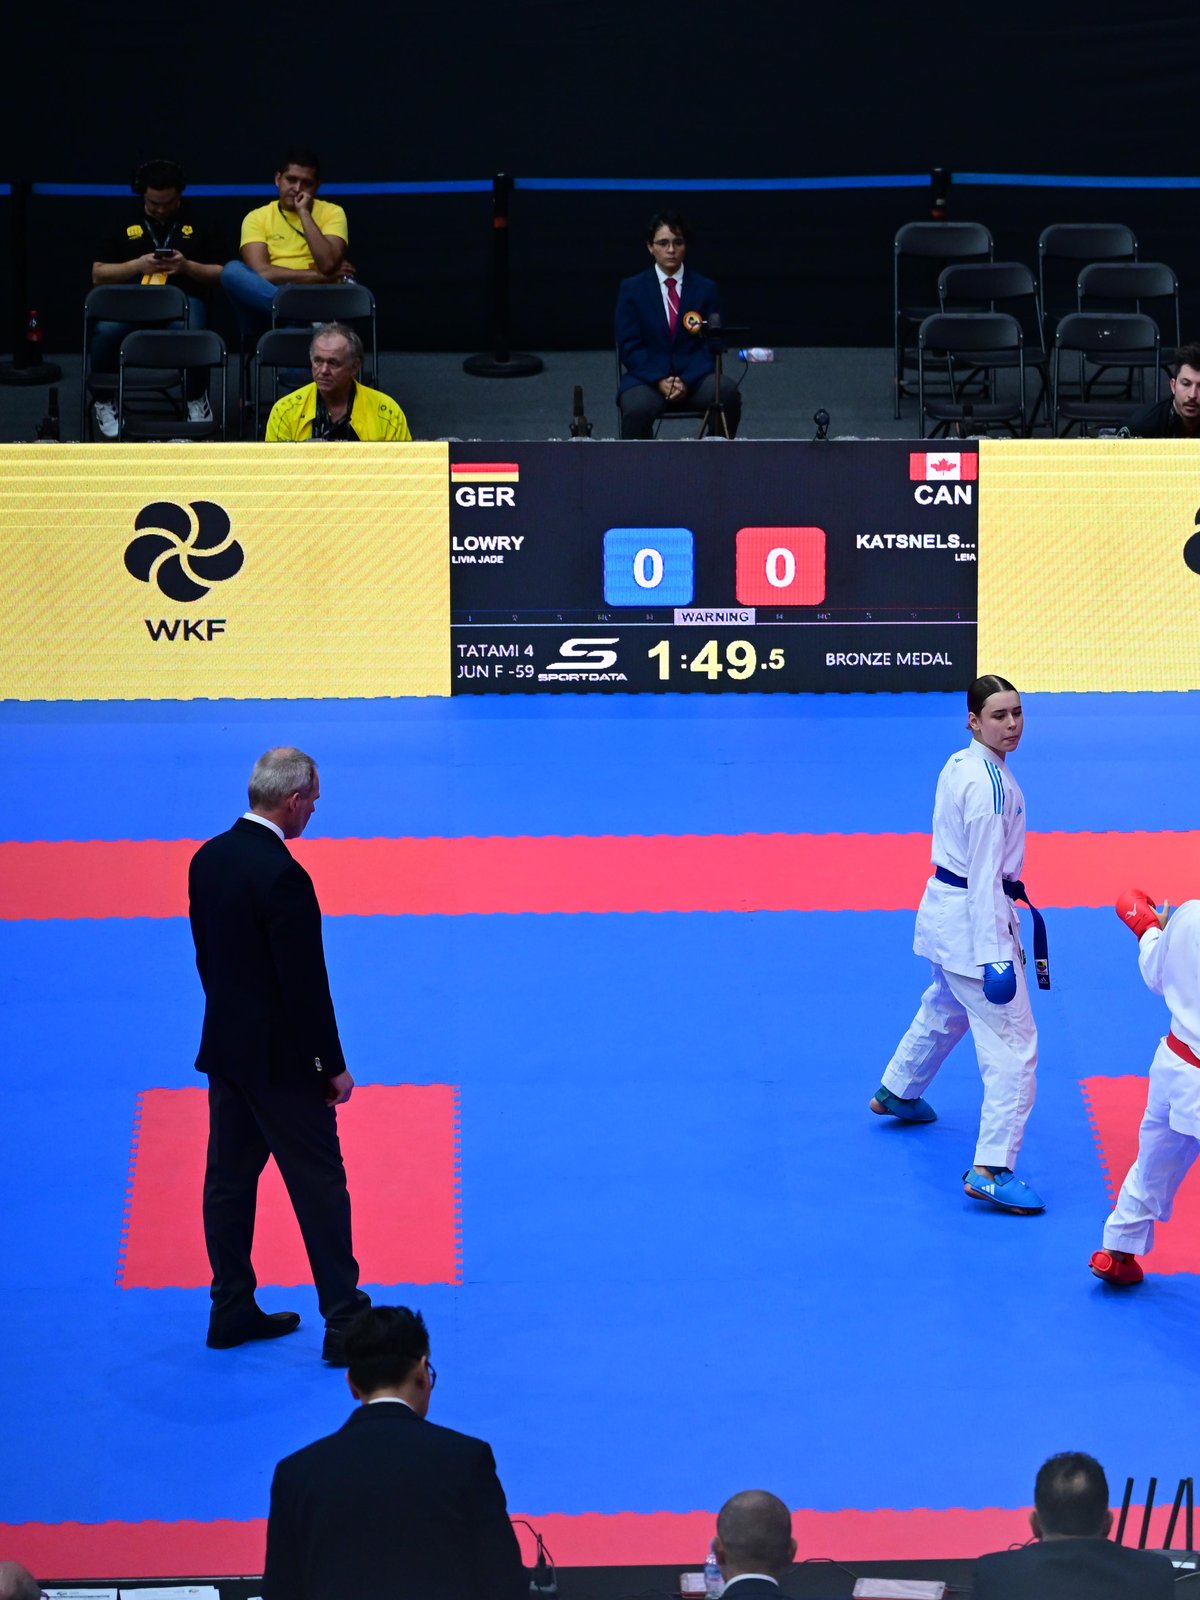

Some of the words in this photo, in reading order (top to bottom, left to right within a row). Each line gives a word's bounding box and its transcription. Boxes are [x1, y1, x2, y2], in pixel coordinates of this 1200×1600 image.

[455, 486, 516, 507] GER
[914, 485, 972, 505] CAN
[452, 535, 525, 551] LOWRY
[856, 534, 976, 549] KATSNELS...
[452, 555, 477, 564] LIVIA
[478, 555, 504, 564] JADE
[954, 553, 976, 562] LEIA
[633, 548, 664, 588] 0
[765, 548, 796, 588] 0
[681, 612, 750, 622] WARNING
[145, 619, 227, 641] WKF
[457, 644, 519, 657] TATAMI
[524, 644, 534, 657] 4
[826, 653, 892, 666] BRONZE
[897, 652, 953, 665] MEDAL
[457, 665, 489, 679] JUN
[495, 665, 503, 678] F
[508, 665, 535, 678] -59
[538, 673, 628, 682] SPORTDATA
